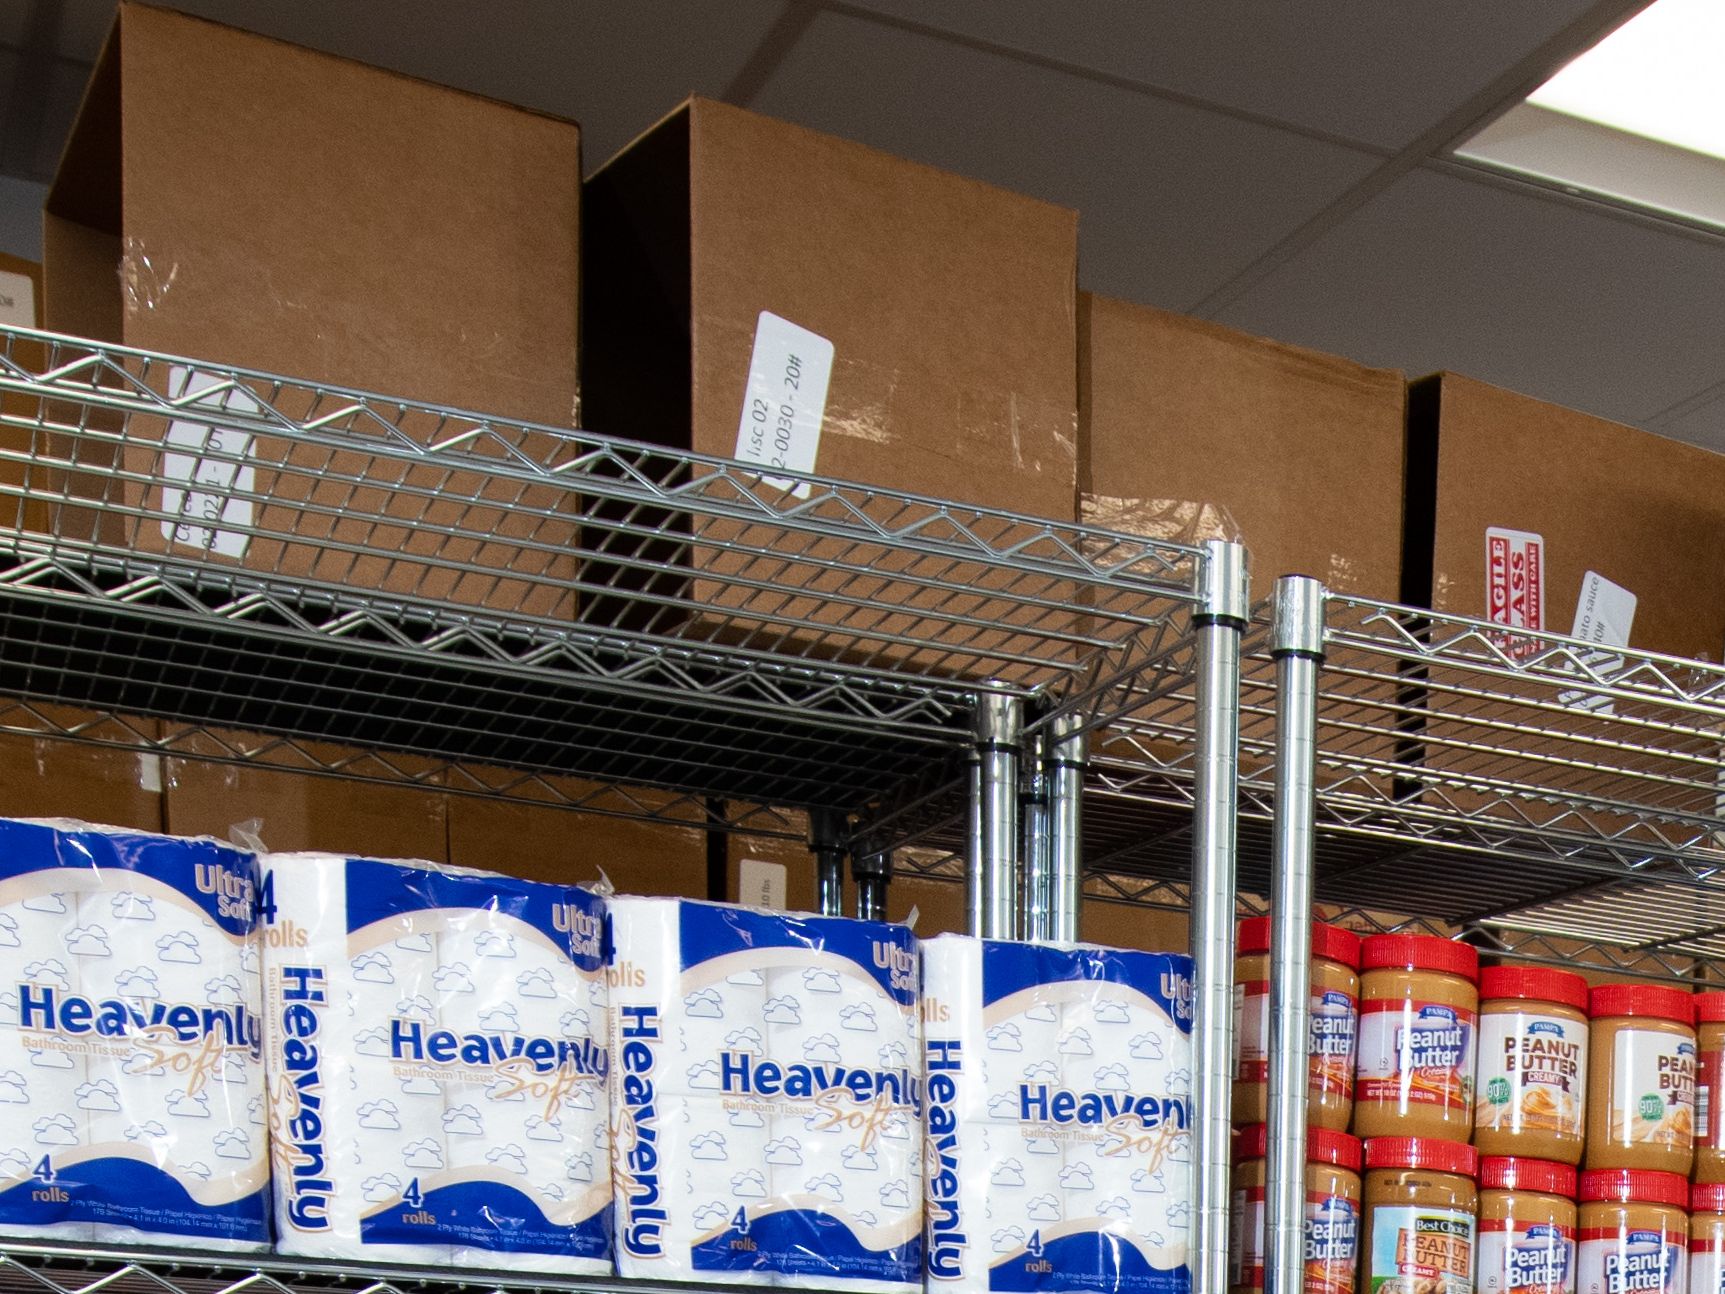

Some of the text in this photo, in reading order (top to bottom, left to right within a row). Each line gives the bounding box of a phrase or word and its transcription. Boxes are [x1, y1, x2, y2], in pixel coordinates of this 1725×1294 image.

[194, 863, 256, 899] Ultra
[17, 981, 263, 1063] Heavenly
[1533, 1021, 1560, 1034] PAMPA
[388, 1015, 610, 1088] Heavenly
[1504, 1036, 1579, 1059] PEANUT
[1506, 1055, 1578, 1079] BUTTER
[1527, 1071, 1561, 1085] CREAMY
[718, 1048, 923, 1120] Heavenly
[278, 963, 337, 1234] Heavenly
[618, 1002, 672, 1260] Heavenly
[33, 1154, 56, 1182] 4
[926, 1038, 970, 1281] Heavenly
[32, 1186, 70, 1203] rolls
[402, 1177, 423, 1206] 4
[401, 1210, 437, 1226] rolls
[730, 1204, 750, 1234] 4
[1416, 1219, 1470, 1236] Best Choice
[729, 1238, 758, 1252] rolls
[1024, 1228, 1044, 1258] 4
[1024, 1260, 1053, 1274] rolls
[1505, 1245, 1568, 1267] Peanut
[1605, 1253, 1670, 1275] Peanut
[1507, 1266, 1565, 1288] Butter
